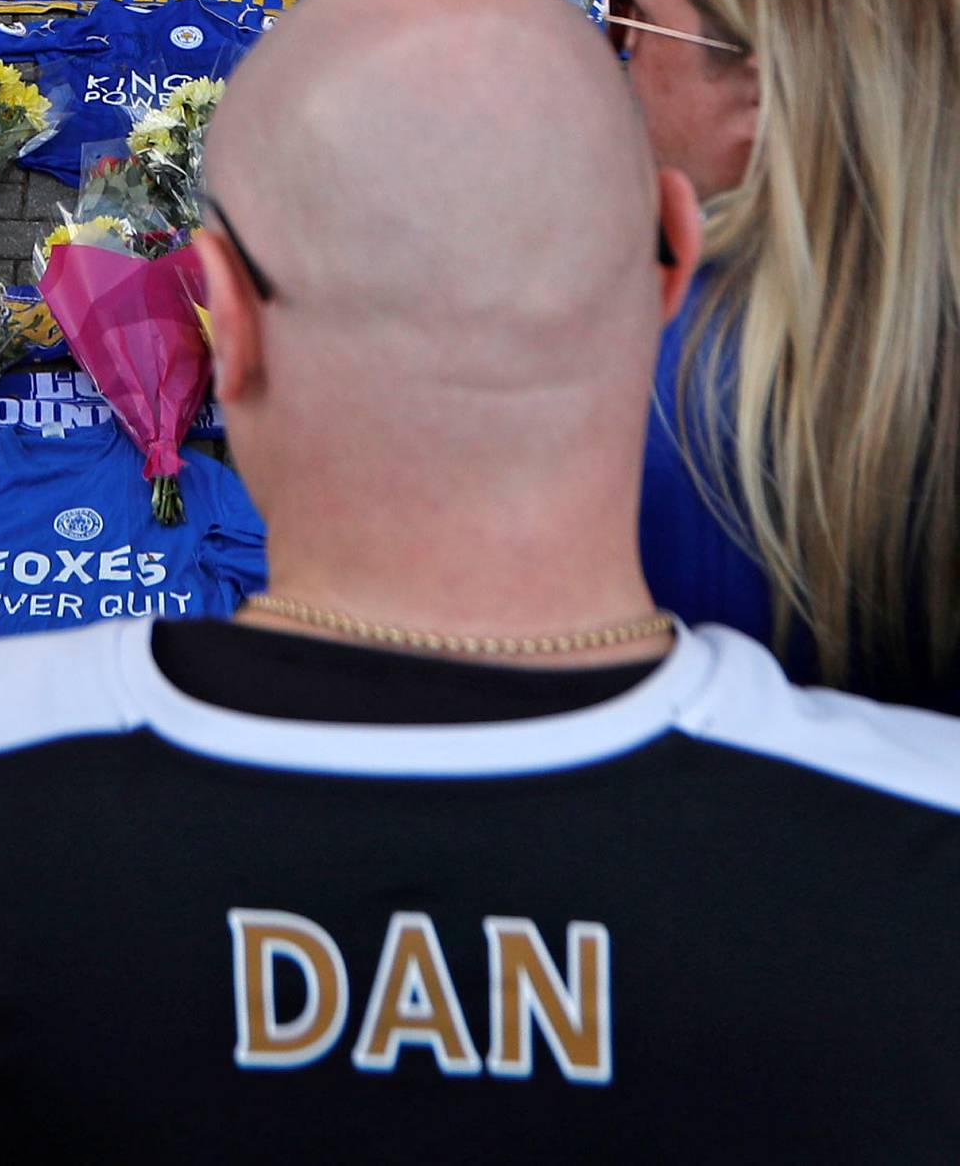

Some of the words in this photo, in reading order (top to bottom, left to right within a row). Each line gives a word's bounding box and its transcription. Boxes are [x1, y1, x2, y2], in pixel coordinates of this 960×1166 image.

[83, 90, 172, 109] POWE
[99, 591, 193, 619] QUIT
[227, 906, 613, 1087] DAN
